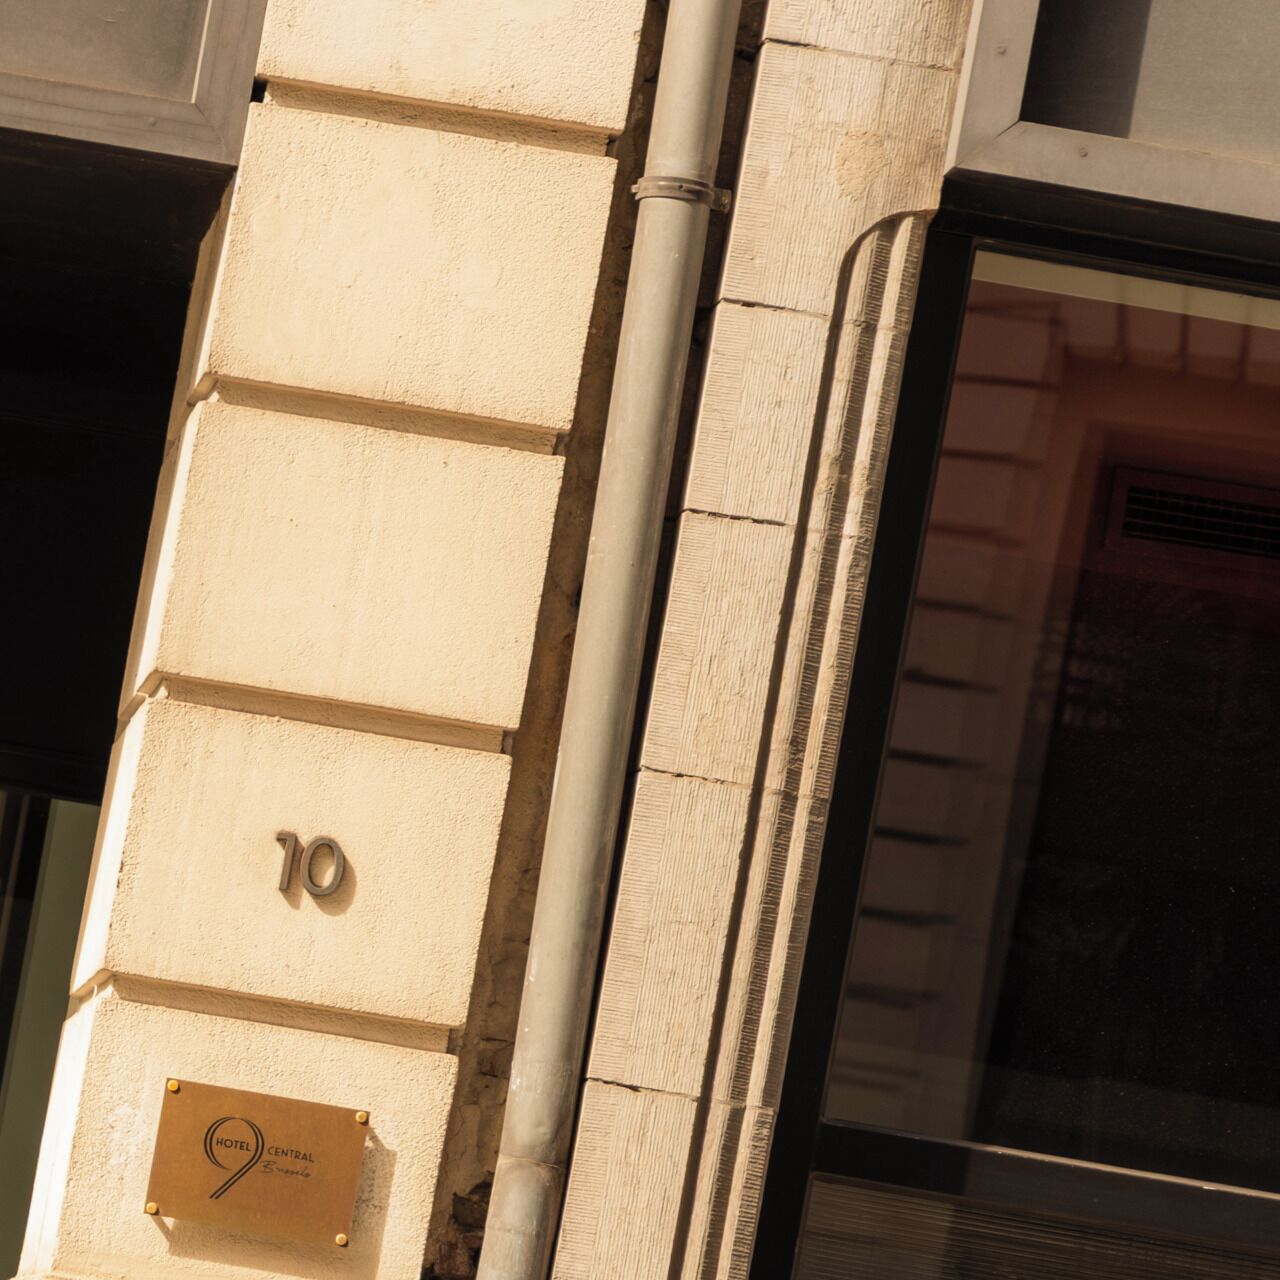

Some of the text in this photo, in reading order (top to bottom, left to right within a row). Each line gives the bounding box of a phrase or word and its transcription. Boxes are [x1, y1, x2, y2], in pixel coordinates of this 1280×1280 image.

[276, 830, 345, 896] 10
[203, 1116, 315, 1199] 9 HOTEL CENTRAL
